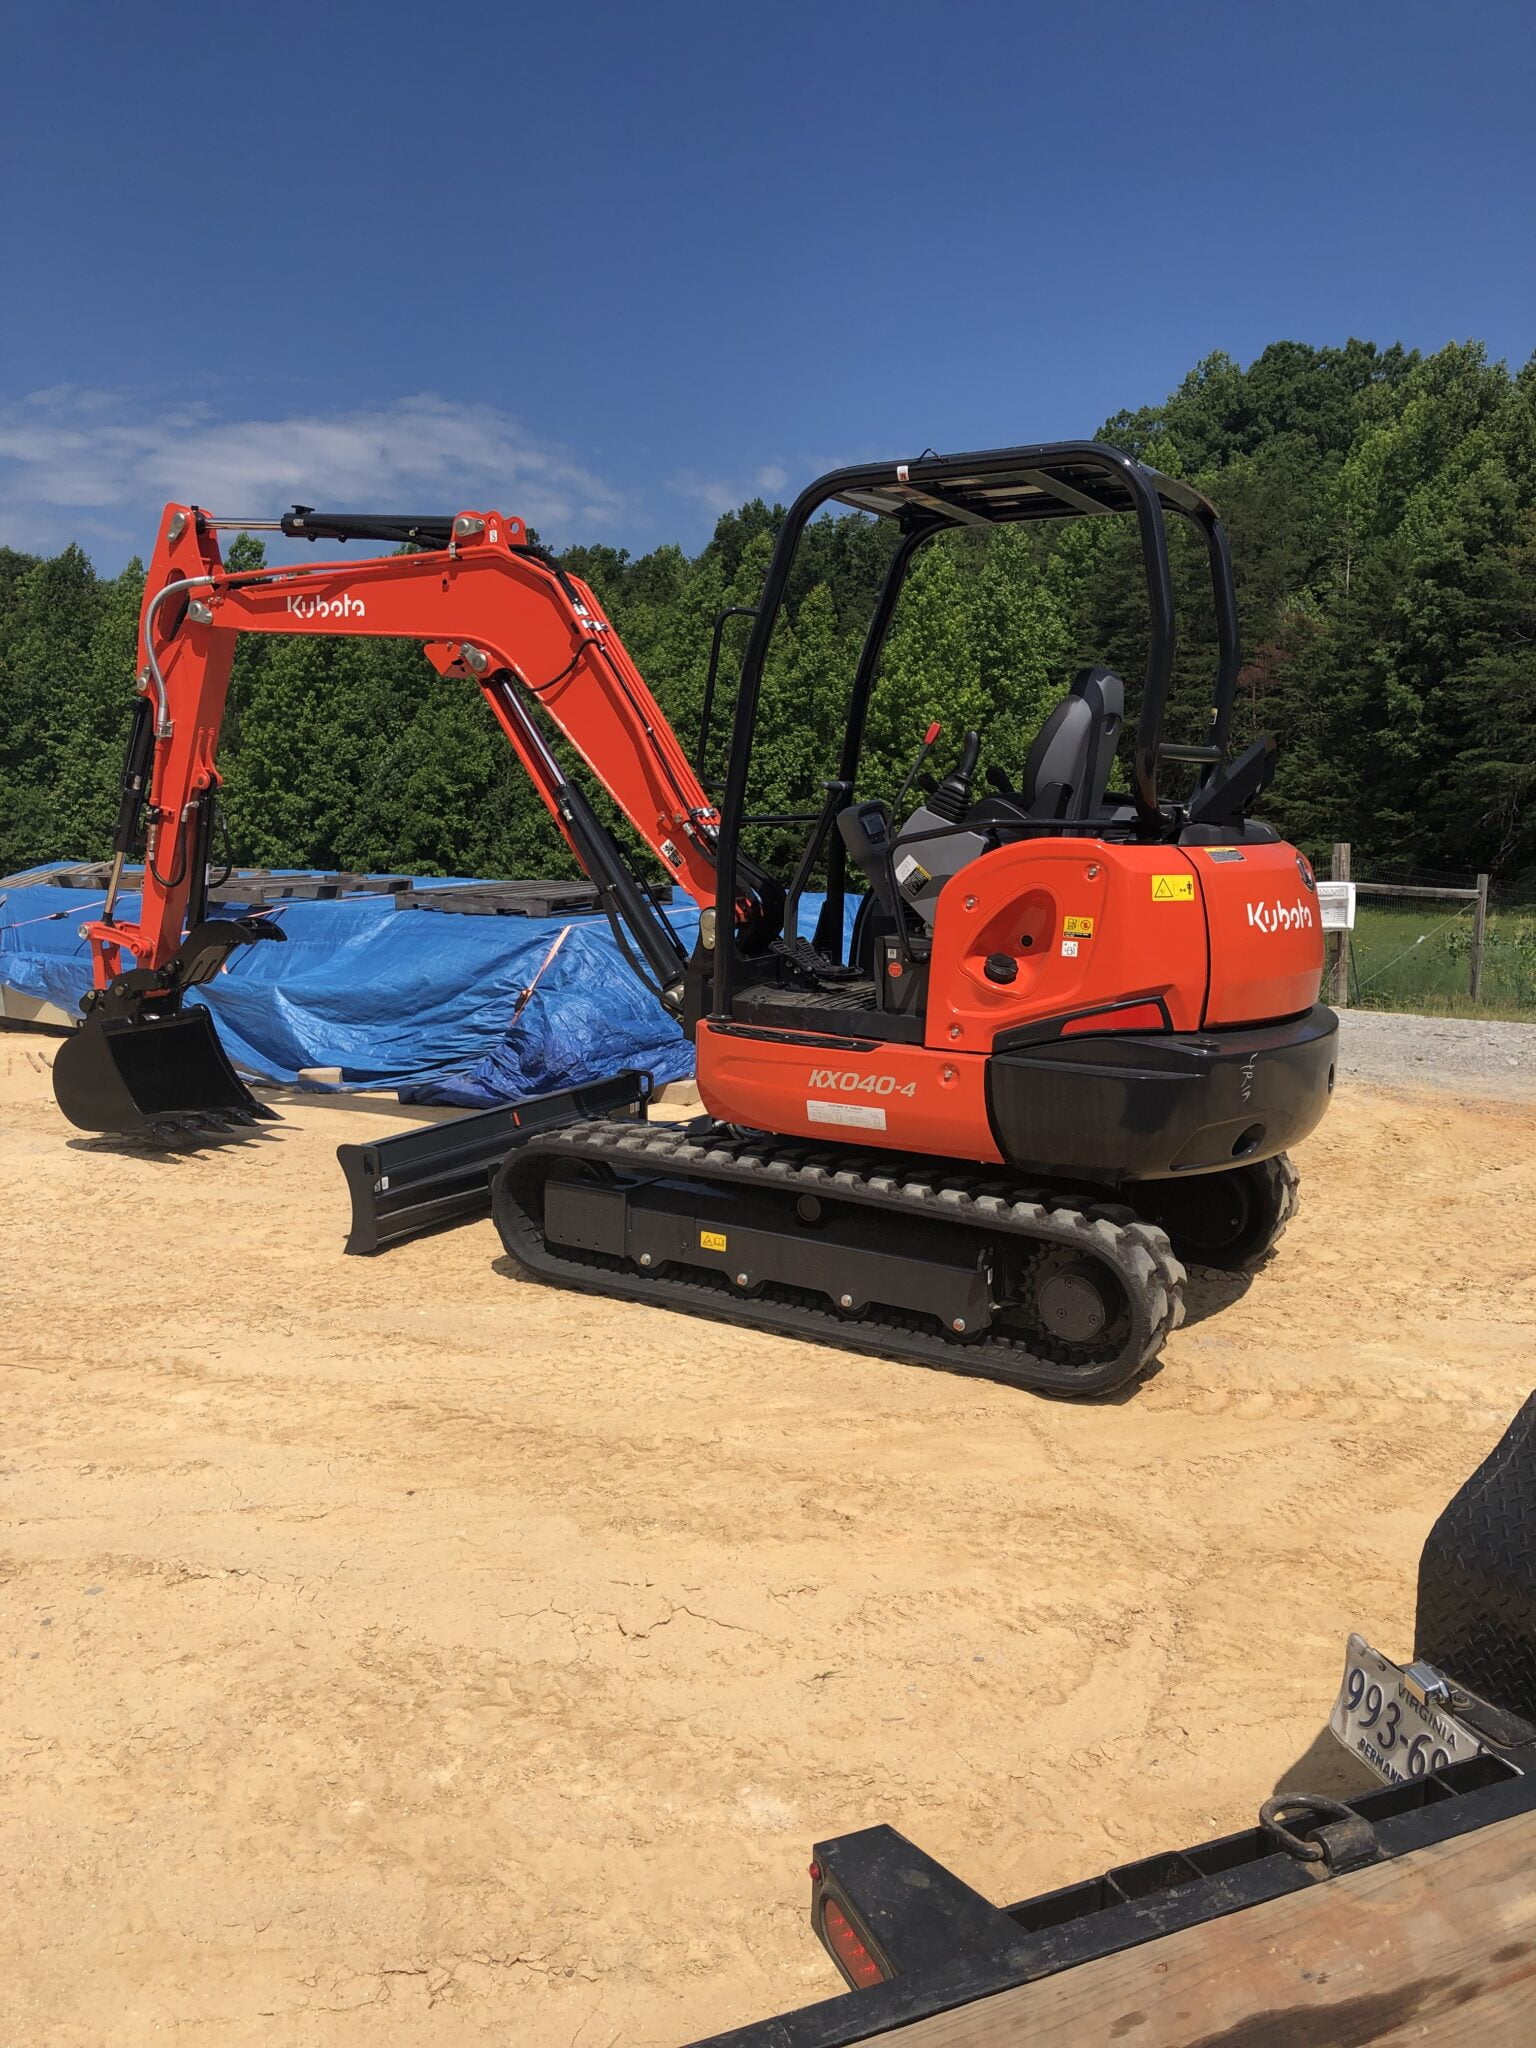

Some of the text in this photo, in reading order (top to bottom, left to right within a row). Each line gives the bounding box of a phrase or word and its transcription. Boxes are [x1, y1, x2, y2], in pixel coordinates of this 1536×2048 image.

[287, 594, 365, 618] Kubota
[1246, 898, 1313, 933] Kubota
[808, 1069, 917, 1097] KX040-4
[1398, 1681, 1457, 1750] VIRGINIA
